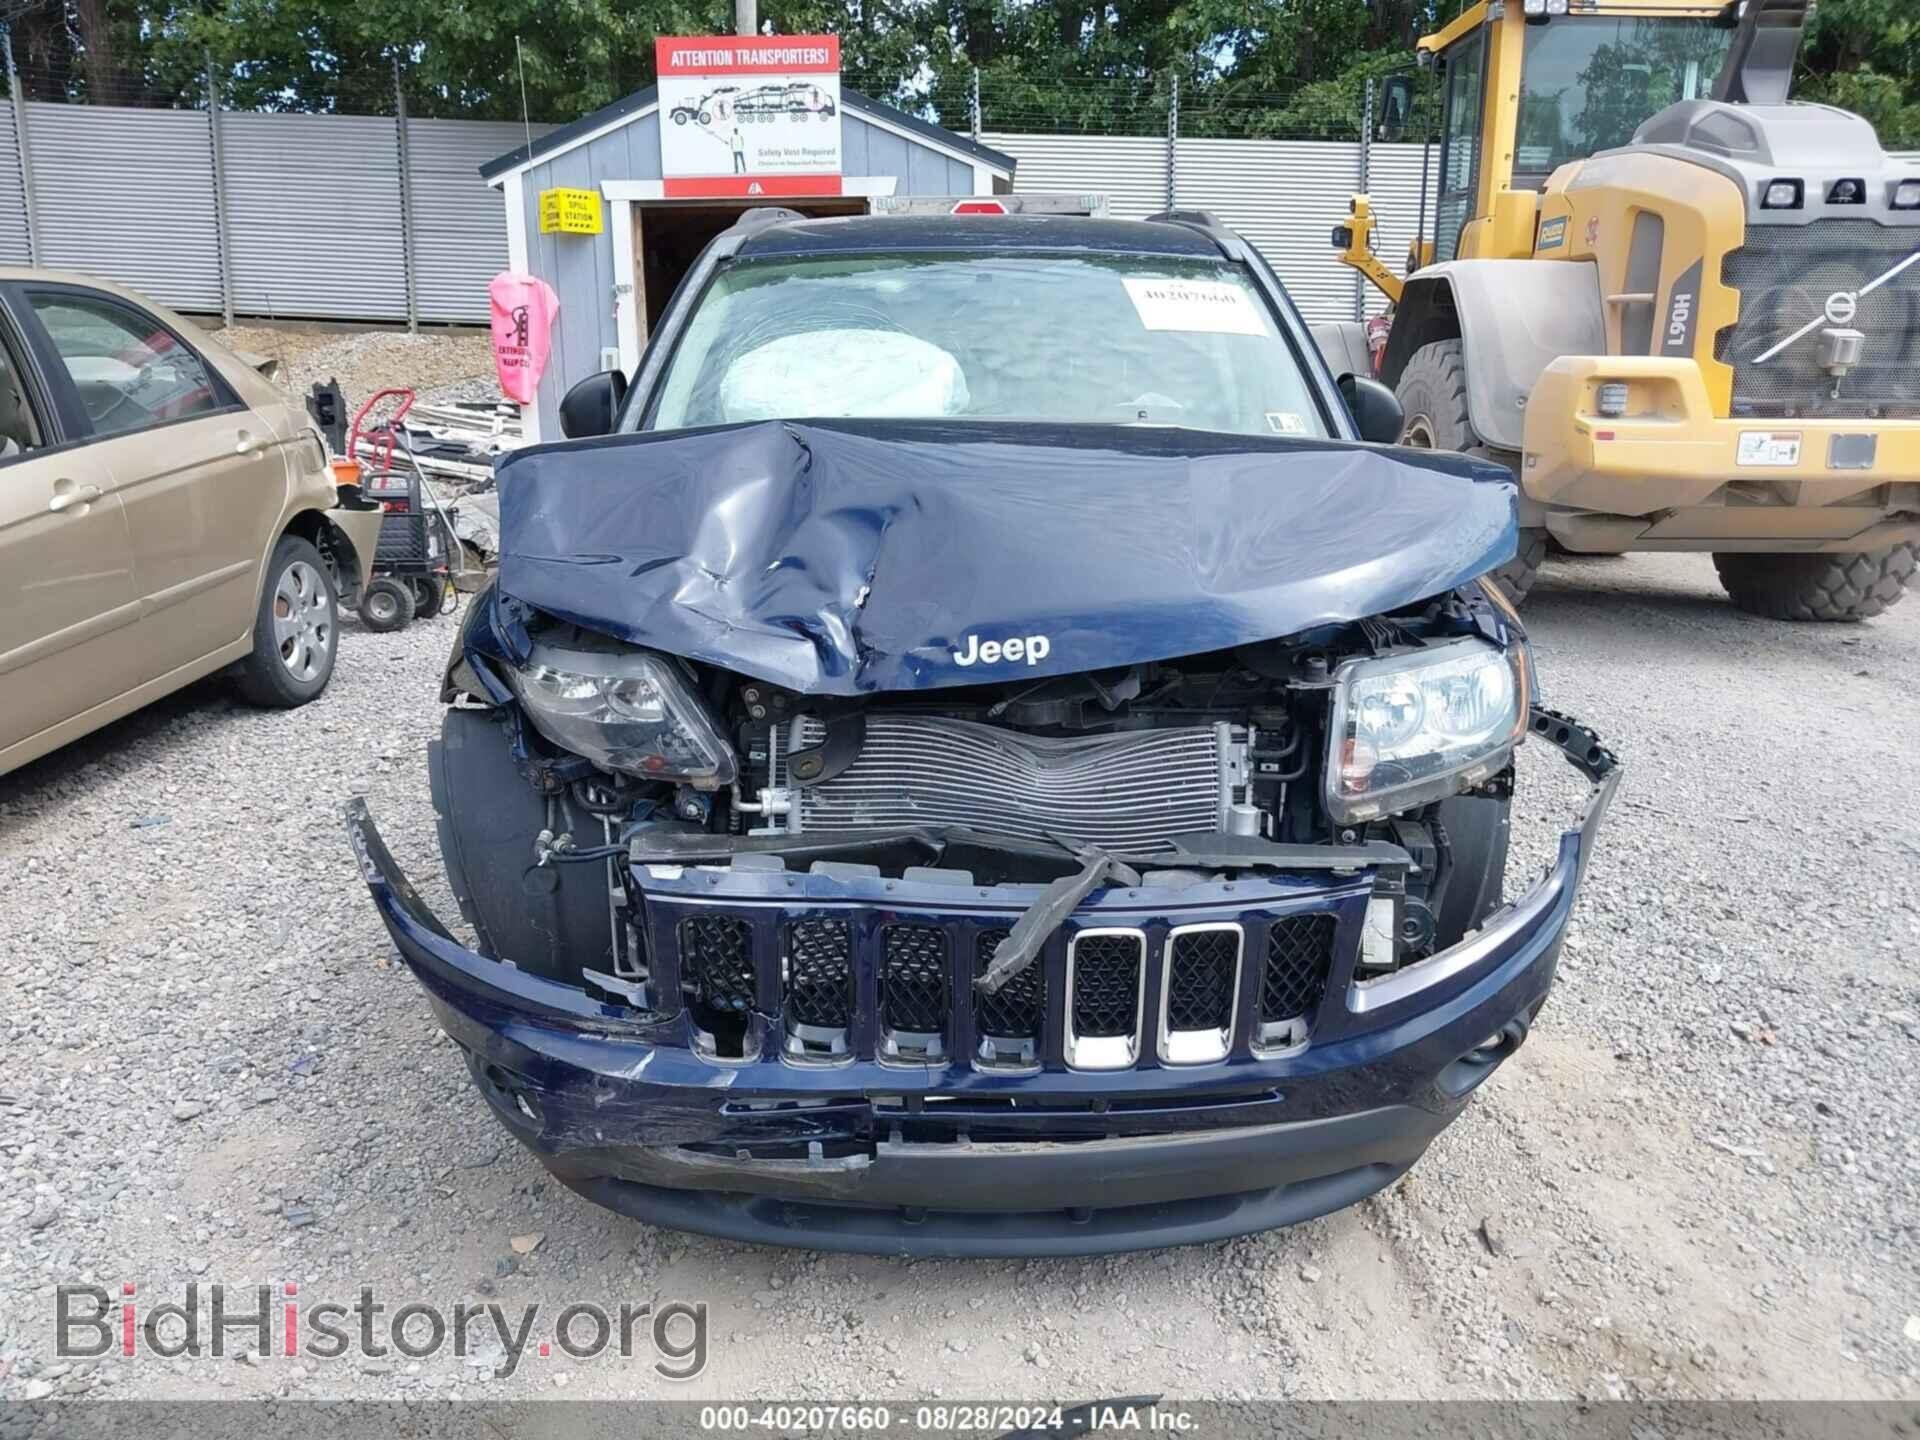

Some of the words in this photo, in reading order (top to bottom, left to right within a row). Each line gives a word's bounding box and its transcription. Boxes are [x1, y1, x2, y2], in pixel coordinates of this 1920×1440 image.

[671, 50, 733, 67] ATTENTION
[736, 48, 829, 66] TRANSPORTERS!
[758, 148, 782, 158] Safety
[784, 147, 800, 157] Vest
[802, 146, 836, 158] Required
[568, 200, 588, 211] SPILL
[564, 211, 593, 222] STATION
[1667, 294, 1692, 345] L90H
[953, 635, 1050, 666] Jeep
